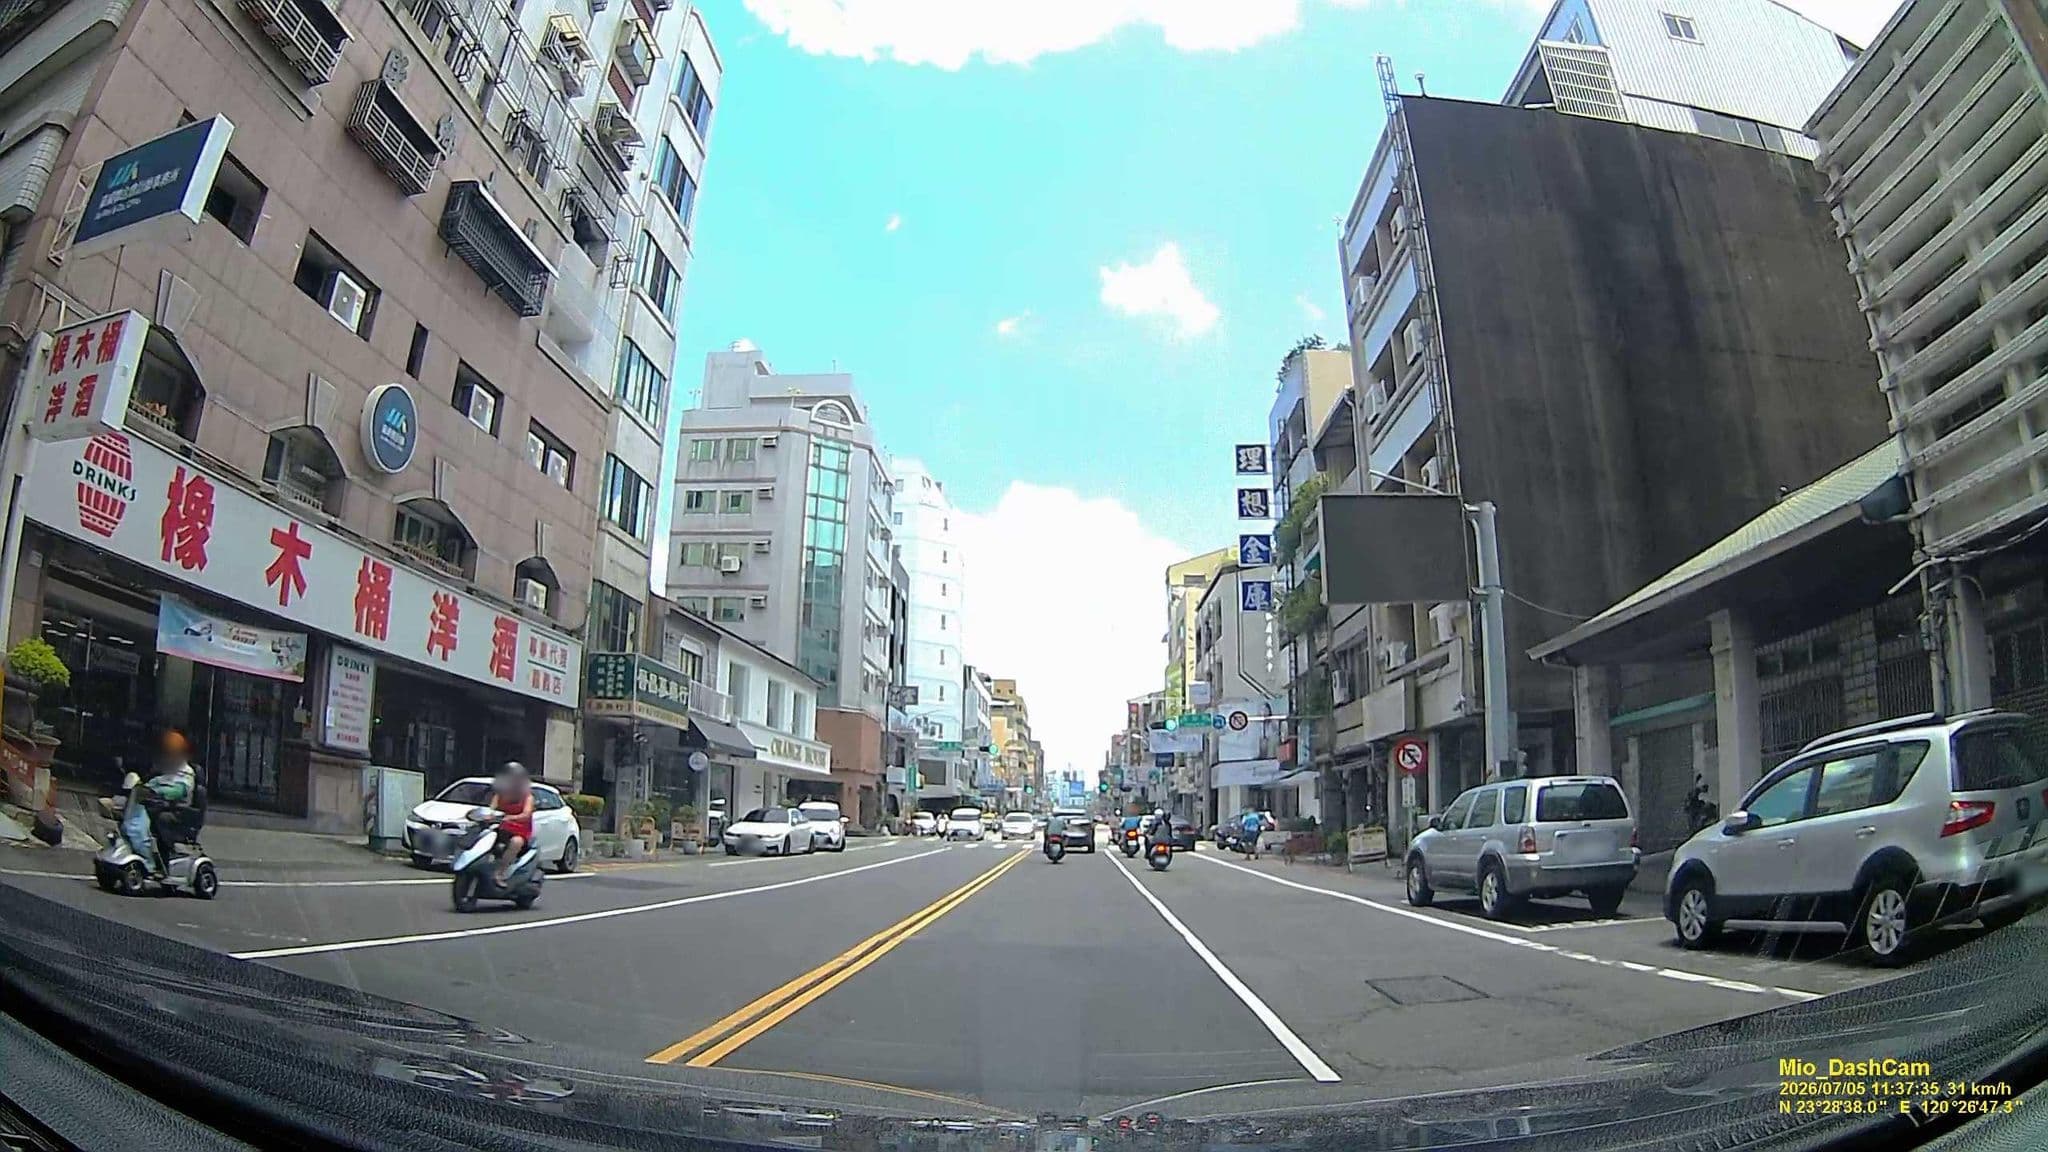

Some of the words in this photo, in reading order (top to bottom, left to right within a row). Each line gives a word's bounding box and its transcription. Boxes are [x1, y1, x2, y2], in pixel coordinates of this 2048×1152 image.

[48, 320, 123, 376] 橡木桶
[44, 374, 99, 424] 洋酒
[72, 460, 137, 501] DRINKS
[1238, 446, 1270, 611] 理想金庫
[161, 465, 519, 683] 橡木桶洋酒
